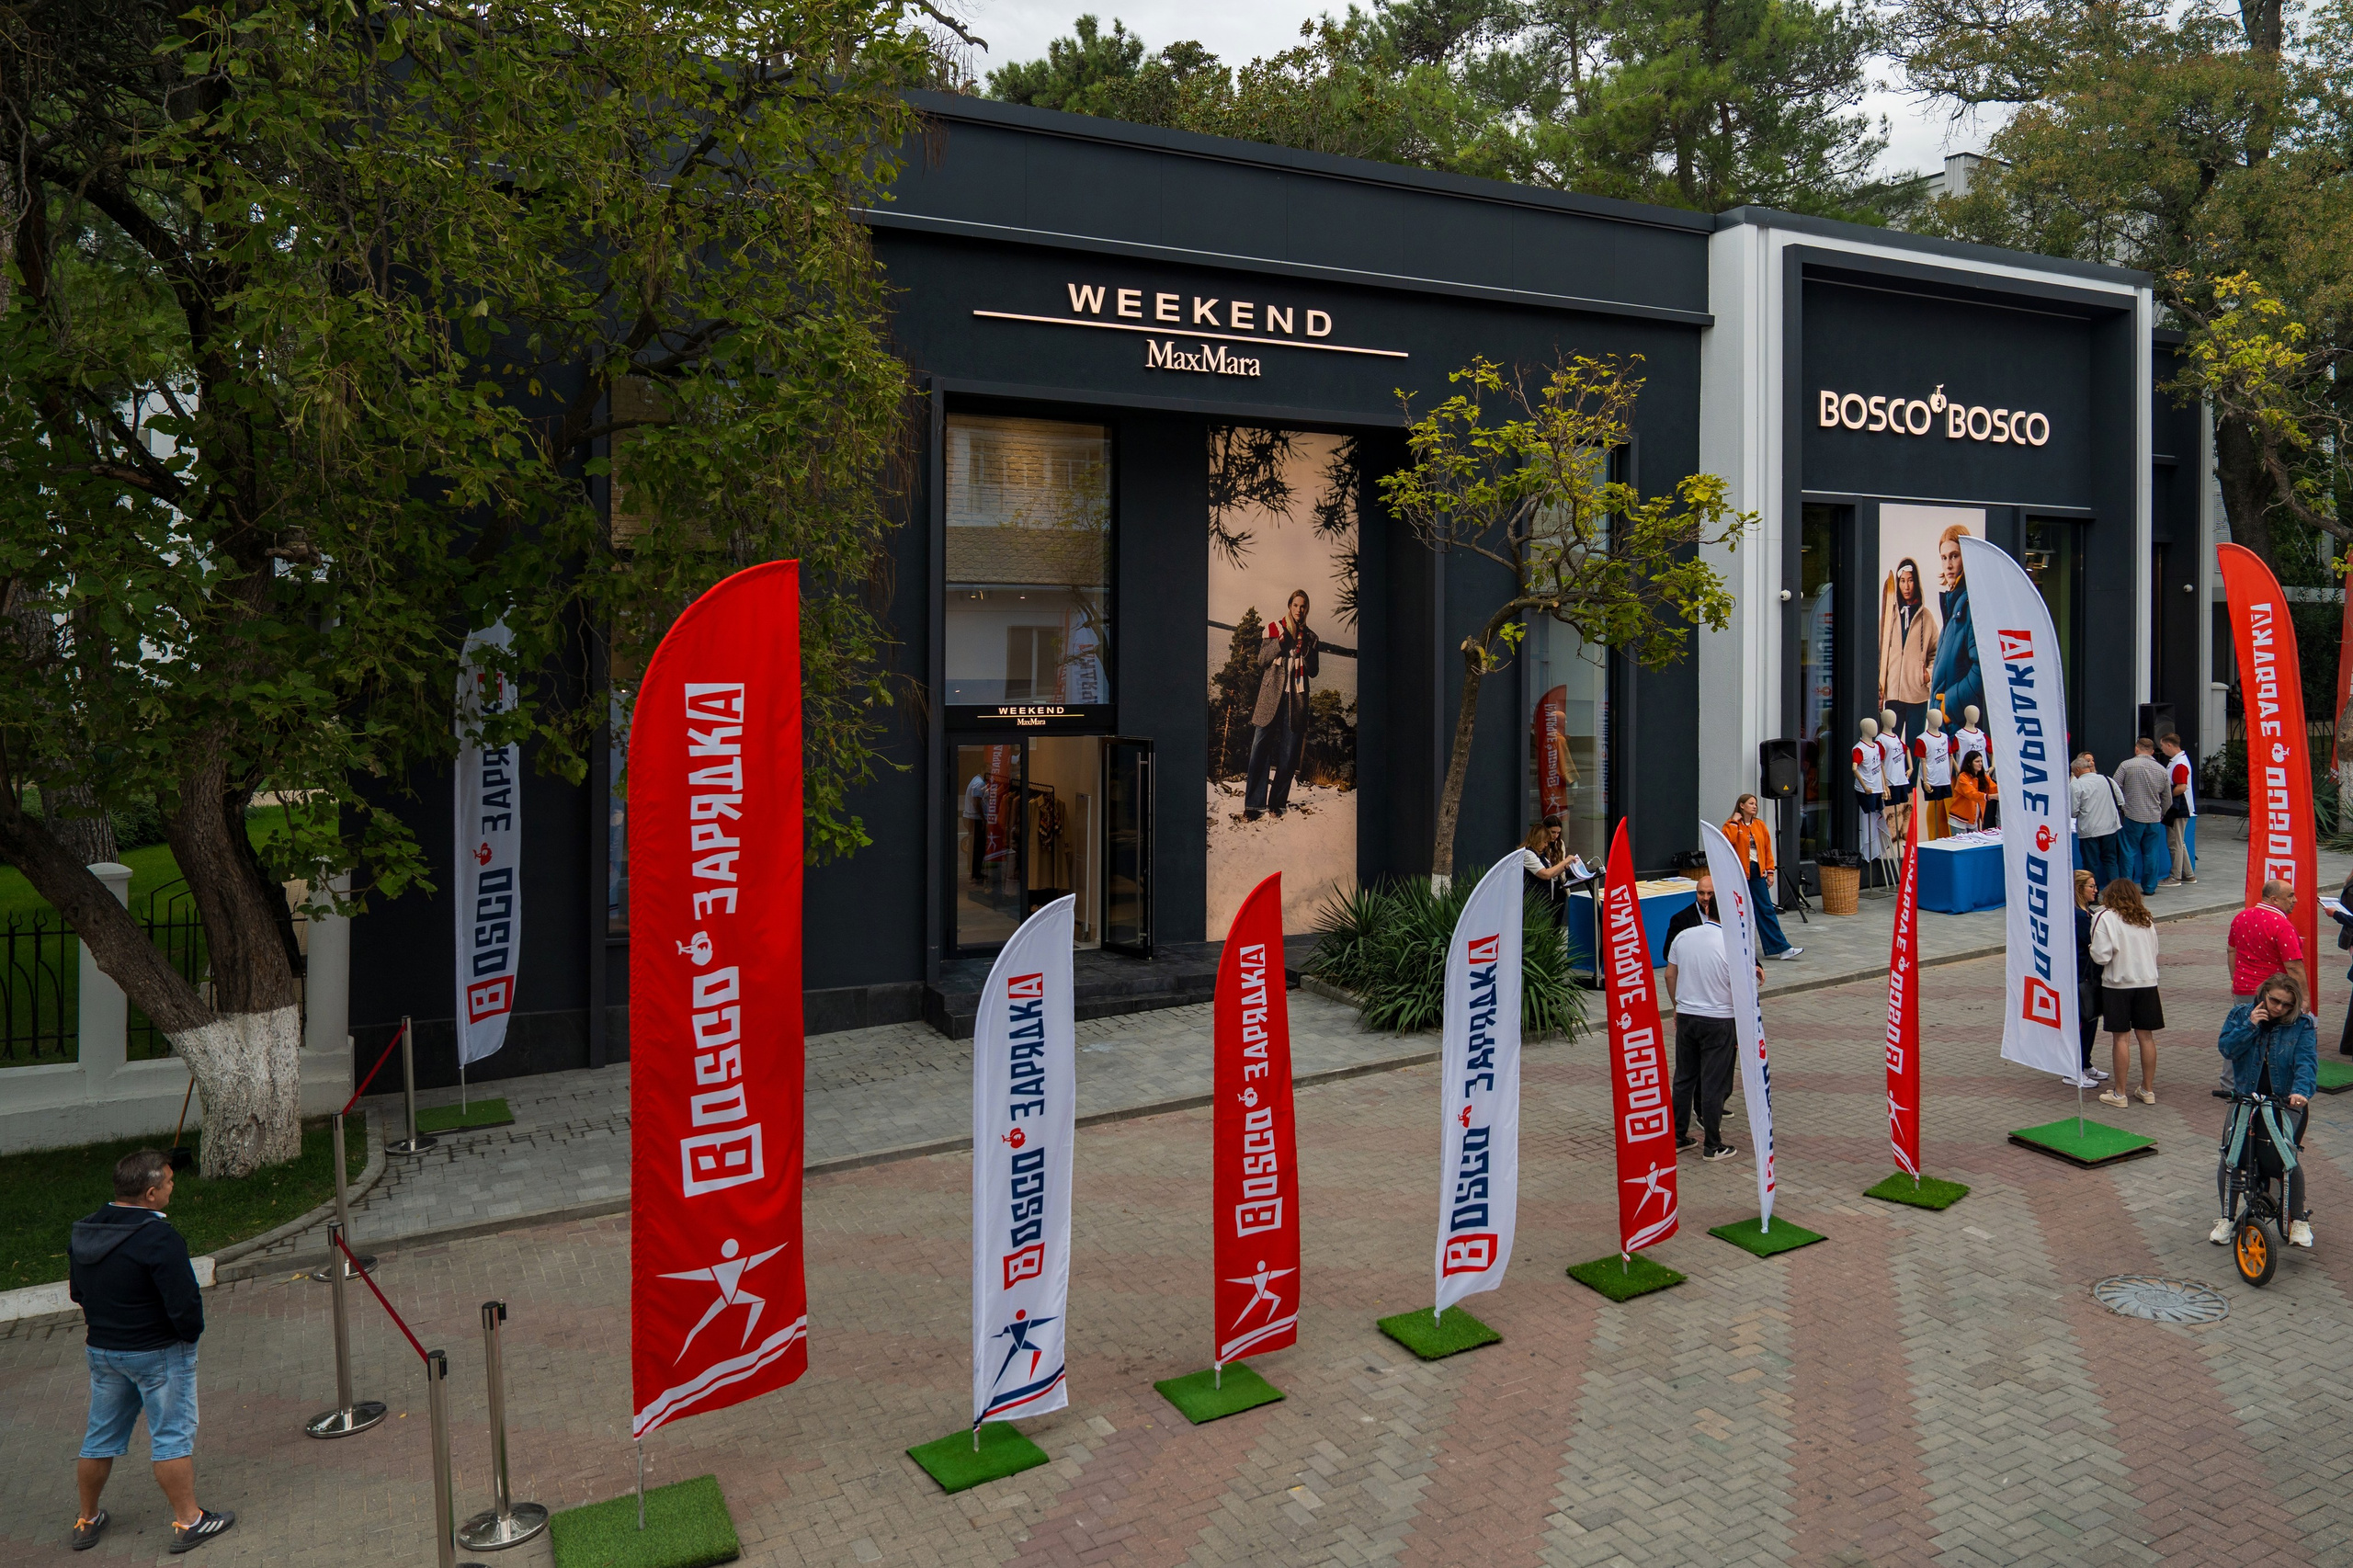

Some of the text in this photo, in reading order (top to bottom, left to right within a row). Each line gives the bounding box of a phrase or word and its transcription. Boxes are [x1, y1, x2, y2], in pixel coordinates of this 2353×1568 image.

[1067, 282, 1333, 337] WEEKEND
[1145, 339, 1261, 378] MaxMara
[1818, 390, 2051, 447] BOSCO BOSCO
[998, 706, 1065, 715] WEEKEND
[1017, 718, 1046, 726] MaxMara
[466, 867, 515, 1025] BOSCO
[680, 682, 765, 1199] BOSCO ЗАРЯДКА
[1610, 884, 1670, 1144] BOSCO ЗАРЯДКА
[1003, 972, 1046, 1291] BOSCO ЗАРЯДКА
[1233, 942, 1284, 1238] BOSCO ЗАРЯДКА
[1442, 932, 1500, 1278] BOSCO ЗАРЯДКА
